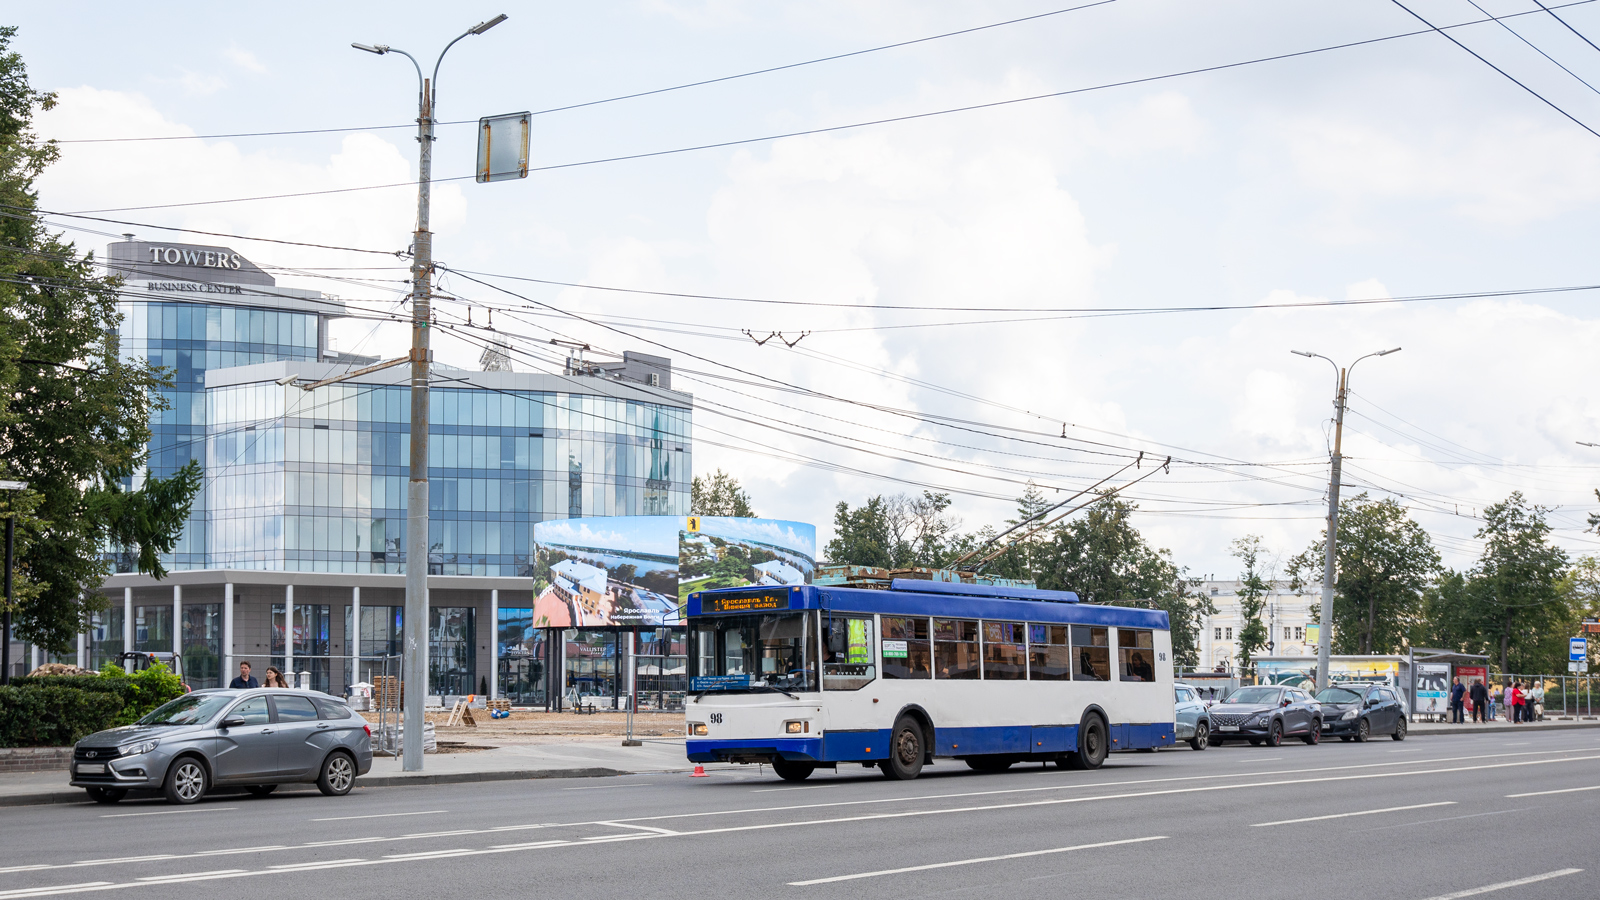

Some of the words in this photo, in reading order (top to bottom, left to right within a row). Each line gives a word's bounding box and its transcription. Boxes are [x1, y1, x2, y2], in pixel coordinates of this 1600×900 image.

[149, 247, 241, 270] TOWERS
[148, 282, 197, 292] BUSINESS
[199, 283, 242, 294] CENTER
[714, 599, 720, 612] 1
[1158, 652, 1166, 661] 98
[710, 712, 723, 724] 98
